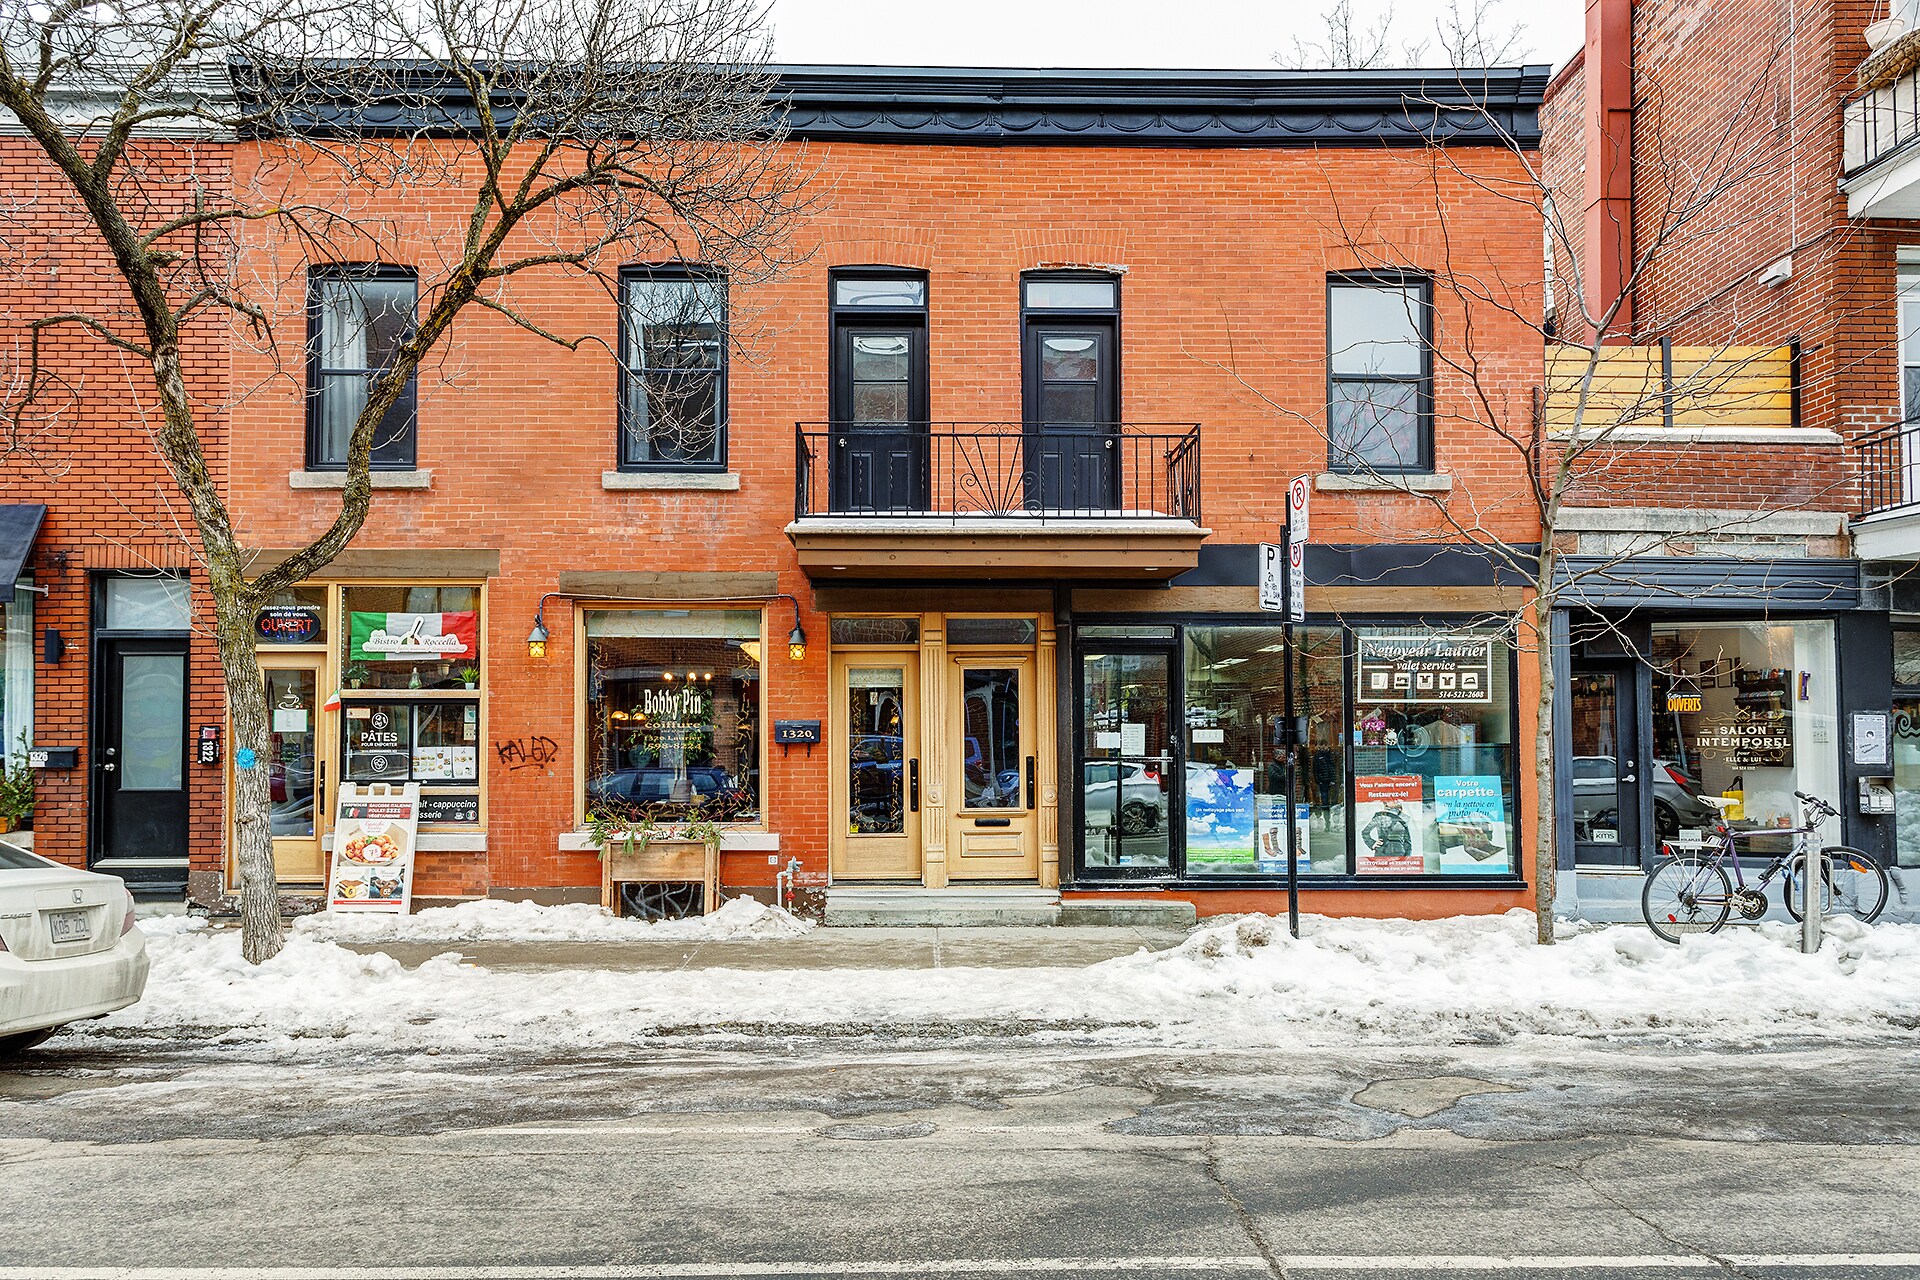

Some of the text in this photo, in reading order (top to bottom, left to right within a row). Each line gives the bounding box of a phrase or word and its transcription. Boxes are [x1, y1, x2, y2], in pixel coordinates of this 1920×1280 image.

[1267, 547, 1275, 570] P
[261, 618, 313, 632] OUVERT
[424, 637, 457, 646] Roccella
[1363, 643, 1487, 660] Nettoyeur Laurier
[1396, 661, 1456, 671] valet service
[644, 689, 702, 720] Bobby Pin
[1667, 697, 1702, 712] OUVERTS
[645, 721, 701, 729] coiffure
[1720, 726, 1767, 735] SALON
[361, 730, 398, 742] PÂTES
[782, 730, 812, 739] 1320
[1696, 737, 1791, 747] INTEMPOREL
[29, 751, 48, 762] 1326
[202, 741, 214, 762] 1322
[433, 800, 477, 809] cappuccino
